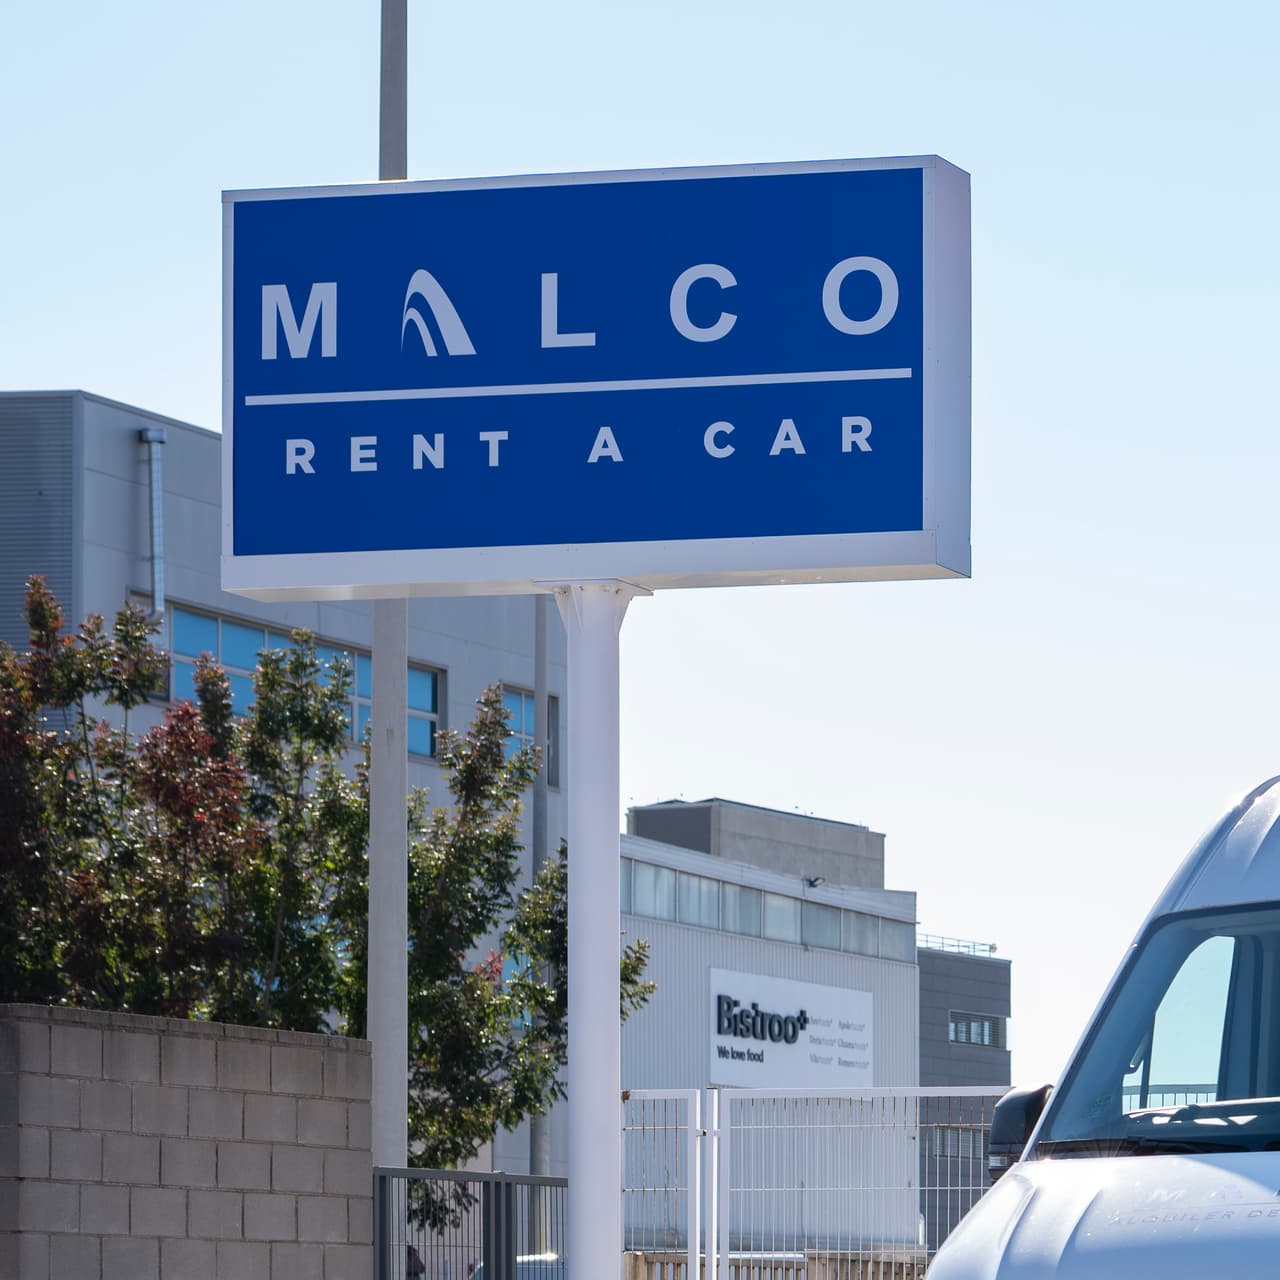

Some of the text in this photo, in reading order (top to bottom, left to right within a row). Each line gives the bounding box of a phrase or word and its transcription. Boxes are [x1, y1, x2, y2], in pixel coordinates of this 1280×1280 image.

[261, 256, 899, 360] MALCO
[285, 415, 873, 475] RENT A CAR
[717, 1045, 765, 1063] We love food
[1247, 1208, 1280, 1219] DE
